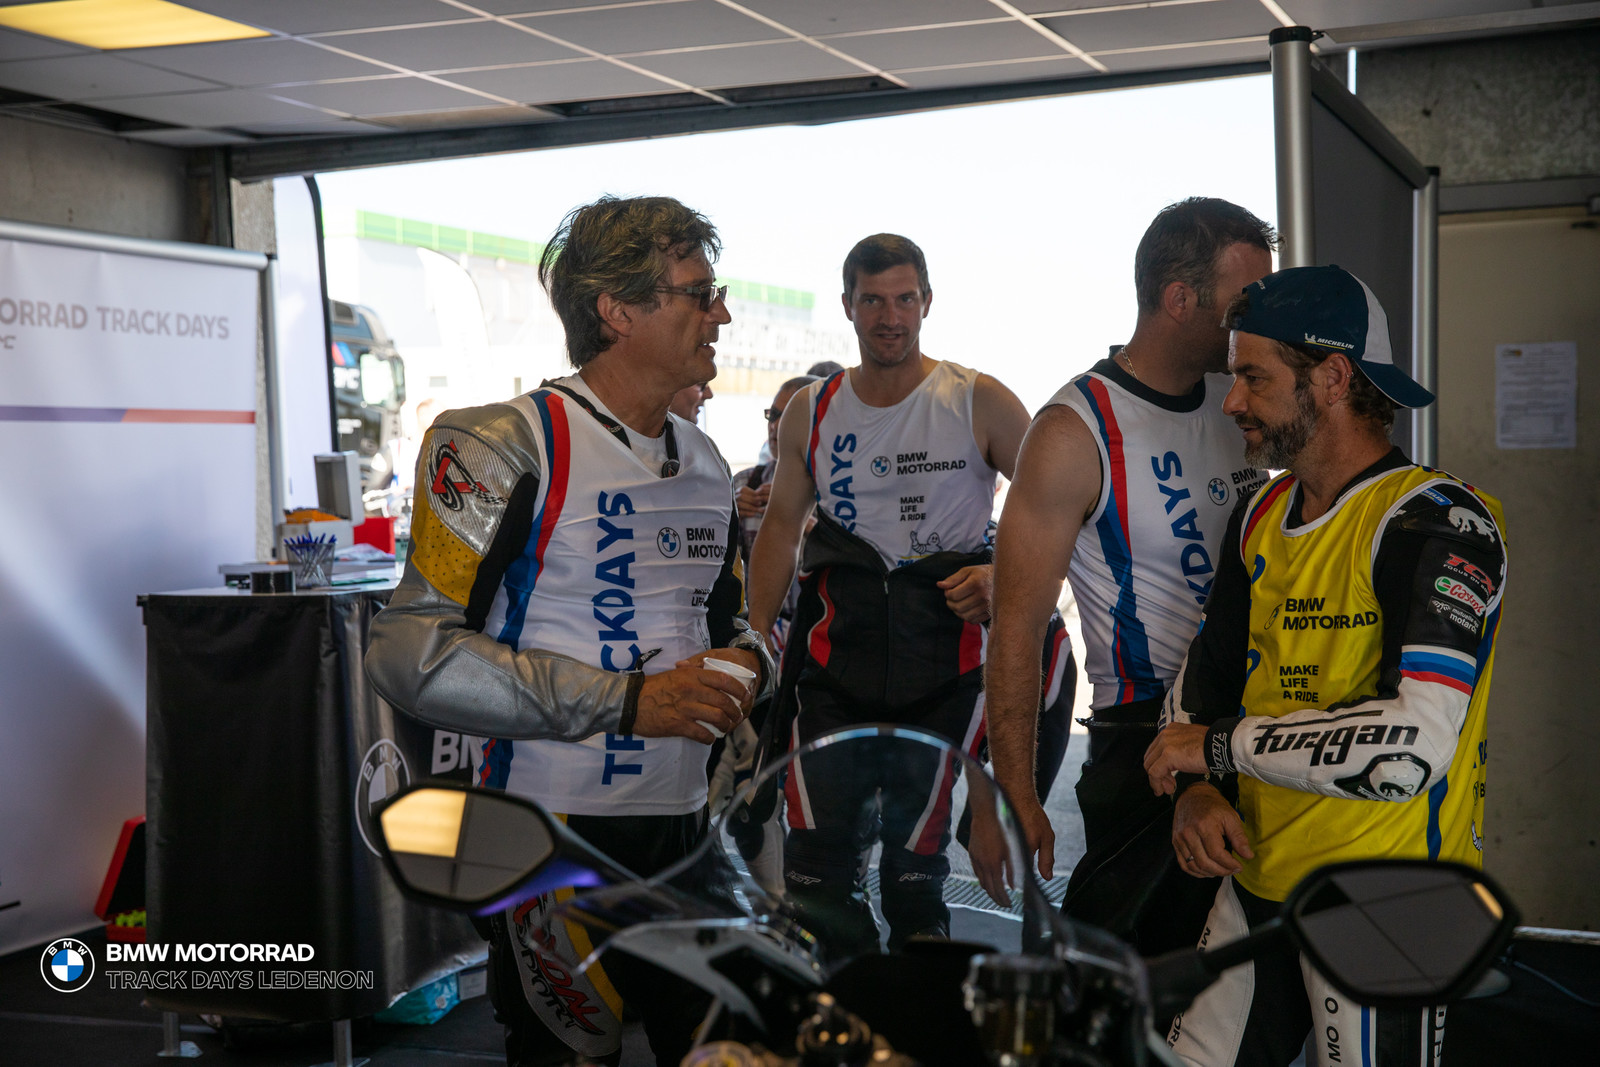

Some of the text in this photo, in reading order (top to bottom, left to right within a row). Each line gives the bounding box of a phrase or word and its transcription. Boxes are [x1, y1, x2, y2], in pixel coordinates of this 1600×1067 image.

[97, 306, 173, 337] TRACK
[176, 313, 230, 340] DAYS
[1317, 337, 1354, 350] MICHELIN
[897, 452, 927, 463] BMW
[897, 460, 966, 475] MOTORRAD
[1231, 467, 1257, 484] BMW
[900, 495, 924, 504] MAKE
[900, 505, 917, 513] LIFE
[908, 513, 926, 521] RIDE
[686, 528, 714, 541] BMW
[1443, 563, 1469, 577] FOCUS
[1285, 598, 1325, 612] BMW
[1450, 584, 1484, 613] Castrol
[1283, 611, 1379, 630] MOTORRAD
[1280, 665, 1319, 676] MAKE
[1281, 678, 1308, 688] LIFE
[1283, 691, 1319, 702] A RIDE
